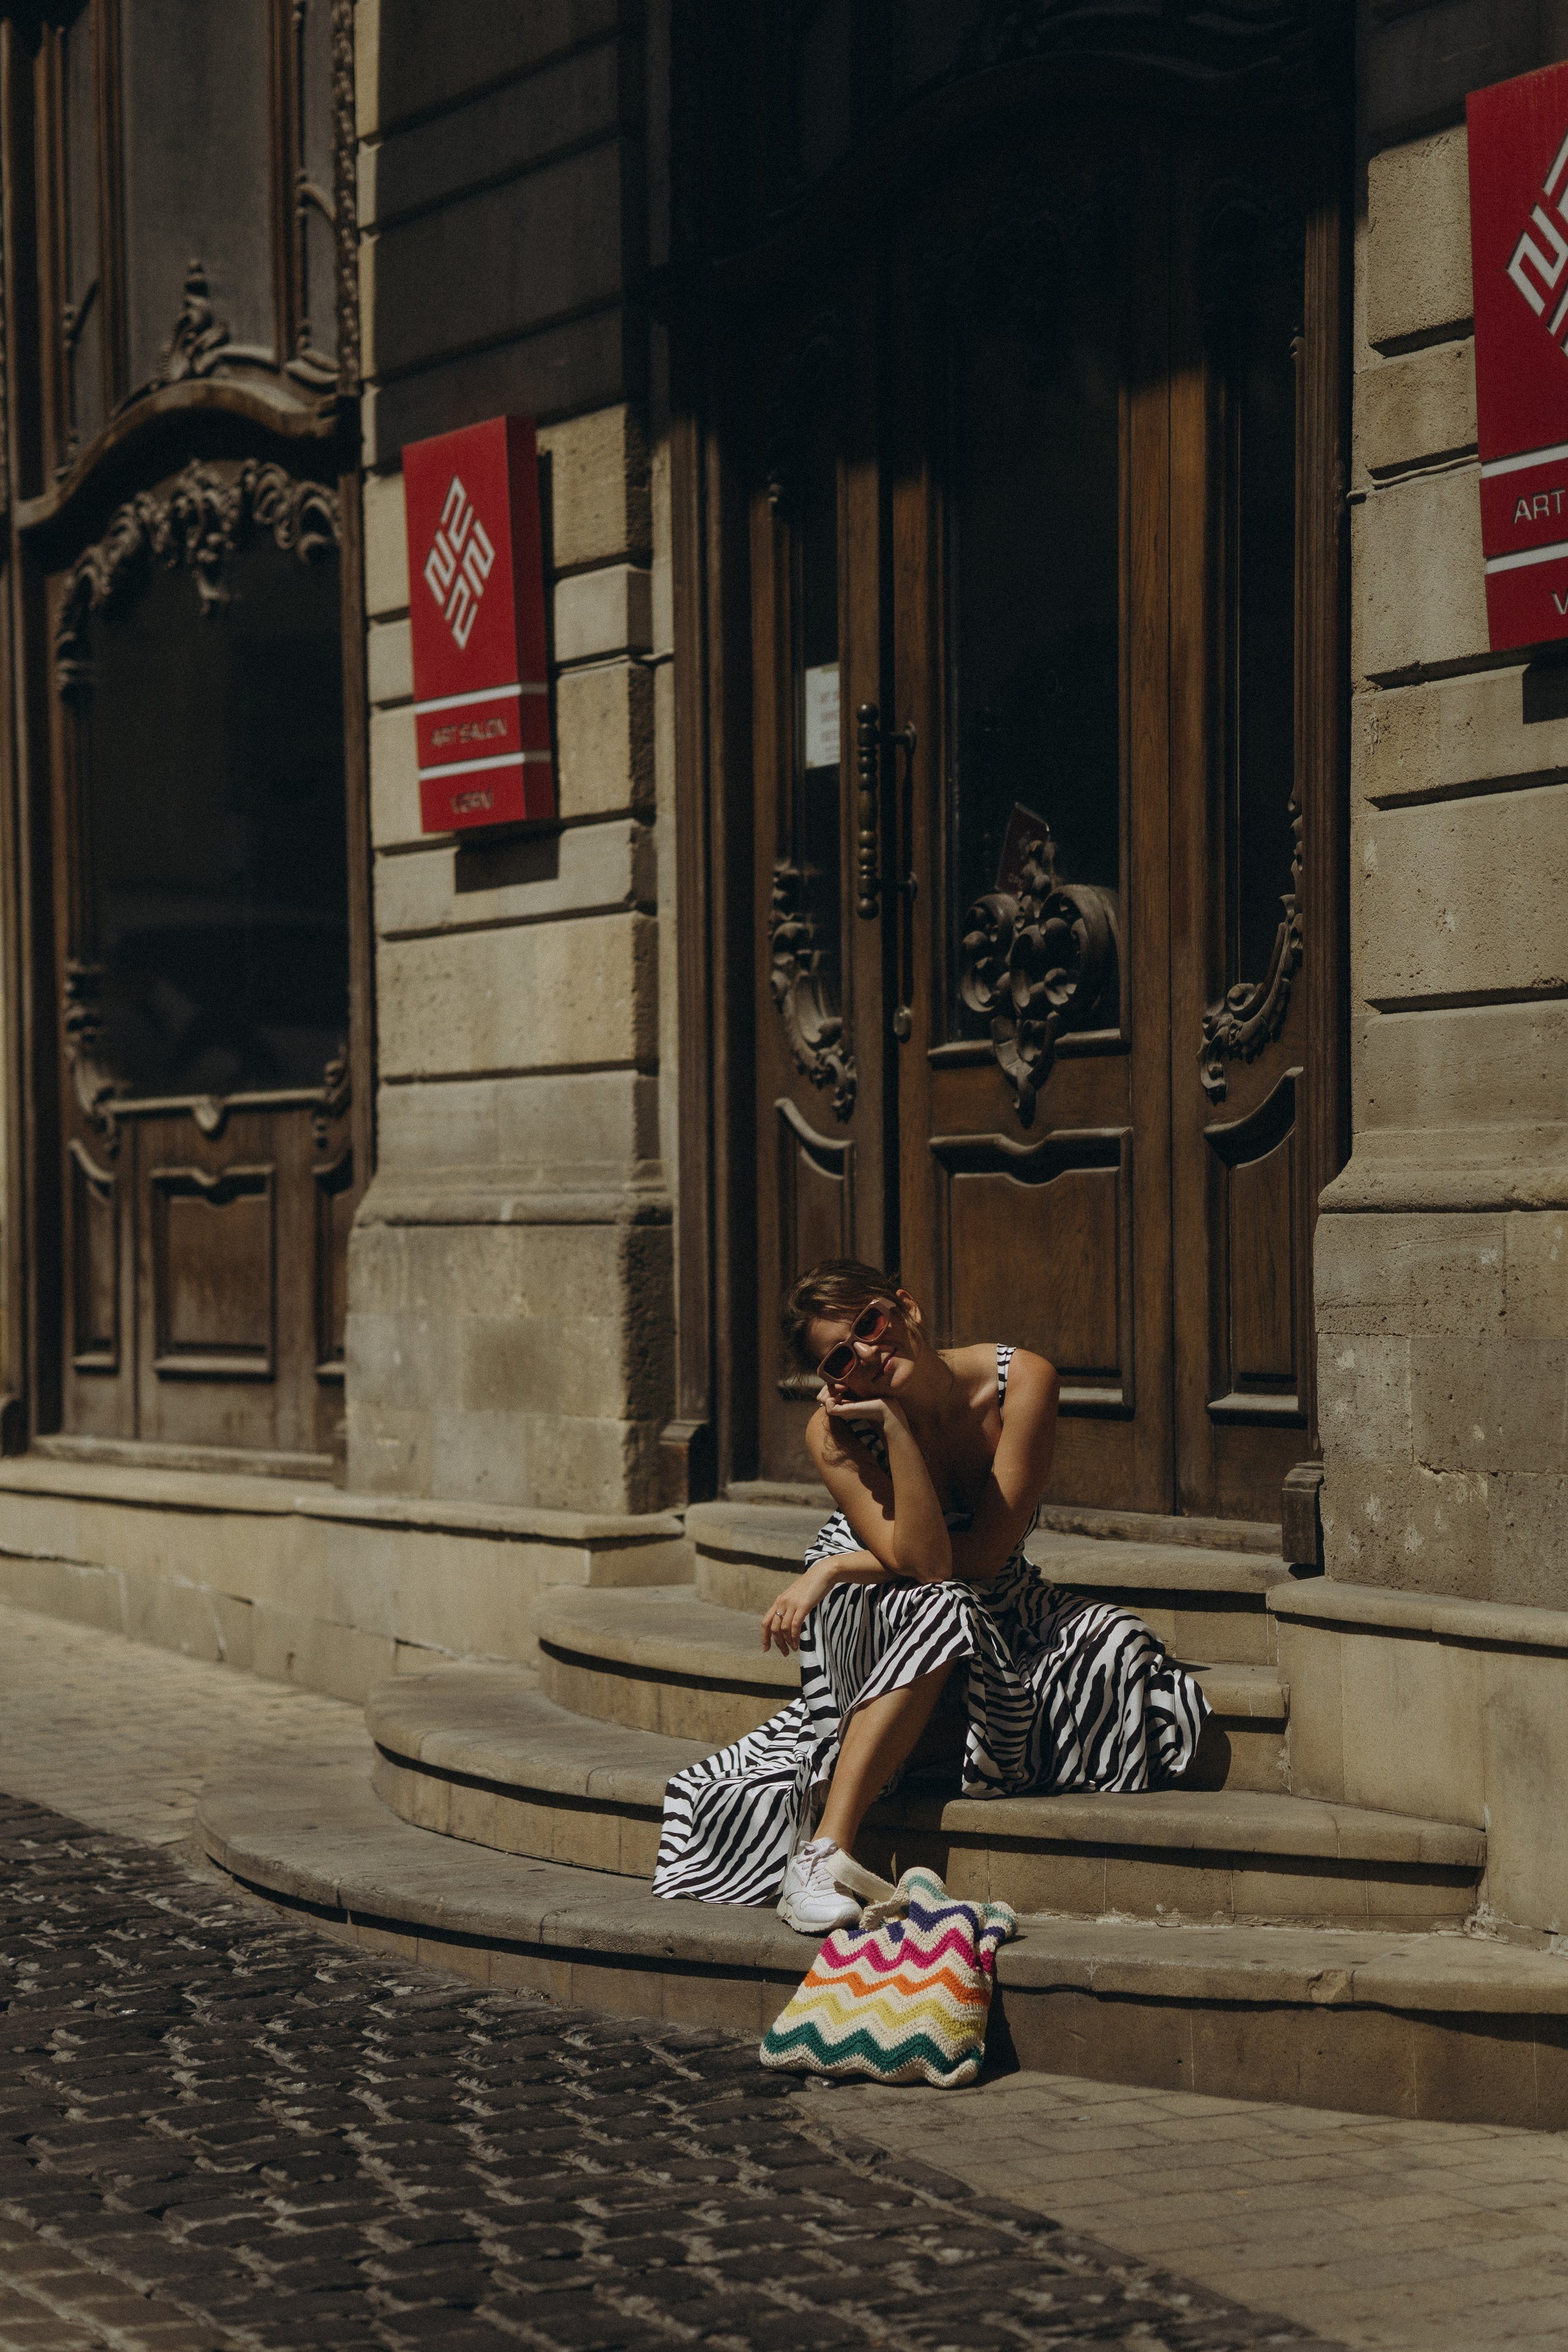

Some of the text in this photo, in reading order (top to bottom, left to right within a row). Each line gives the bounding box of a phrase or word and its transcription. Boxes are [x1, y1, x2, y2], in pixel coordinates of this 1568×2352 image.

[1513, 489, 1566, 524] ART
[431, 717, 508, 747] ART SALON
